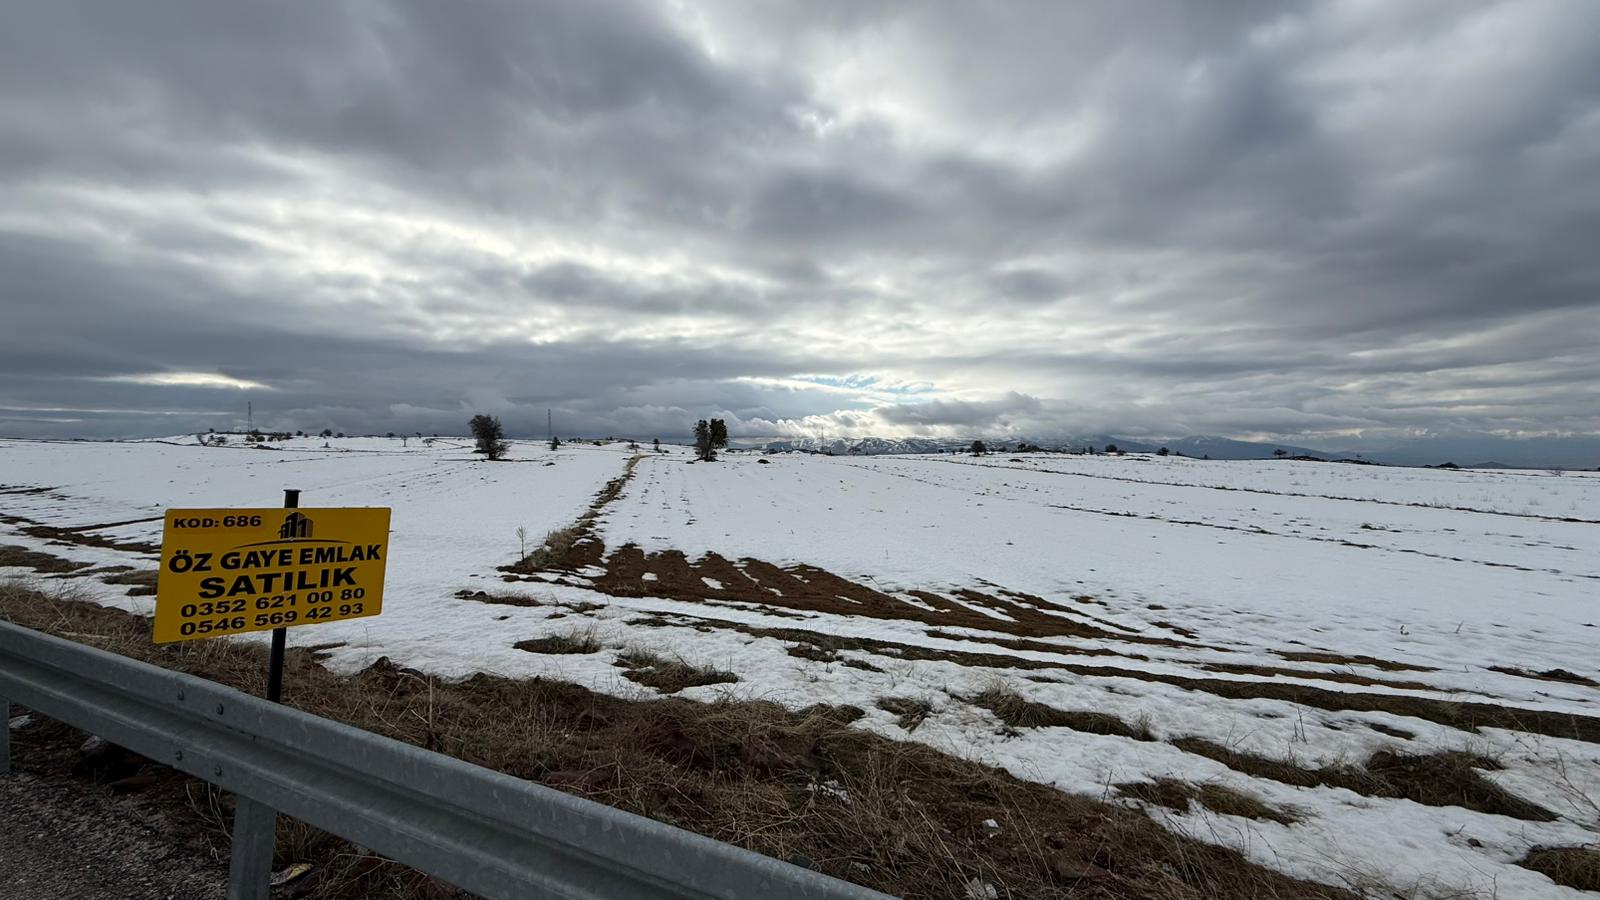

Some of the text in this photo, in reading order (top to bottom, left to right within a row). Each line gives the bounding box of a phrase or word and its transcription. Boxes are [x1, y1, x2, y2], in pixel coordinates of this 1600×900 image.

[173, 515, 262, 528] KOD: 686
[168, 544, 381, 573] ÖZ GAYE EMLAK
[198, 566, 357, 599] SATILIK
[181, 587, 365, 617] 0352 621 00 80
[180, 603, 364, 636] 0546 569 42 93
